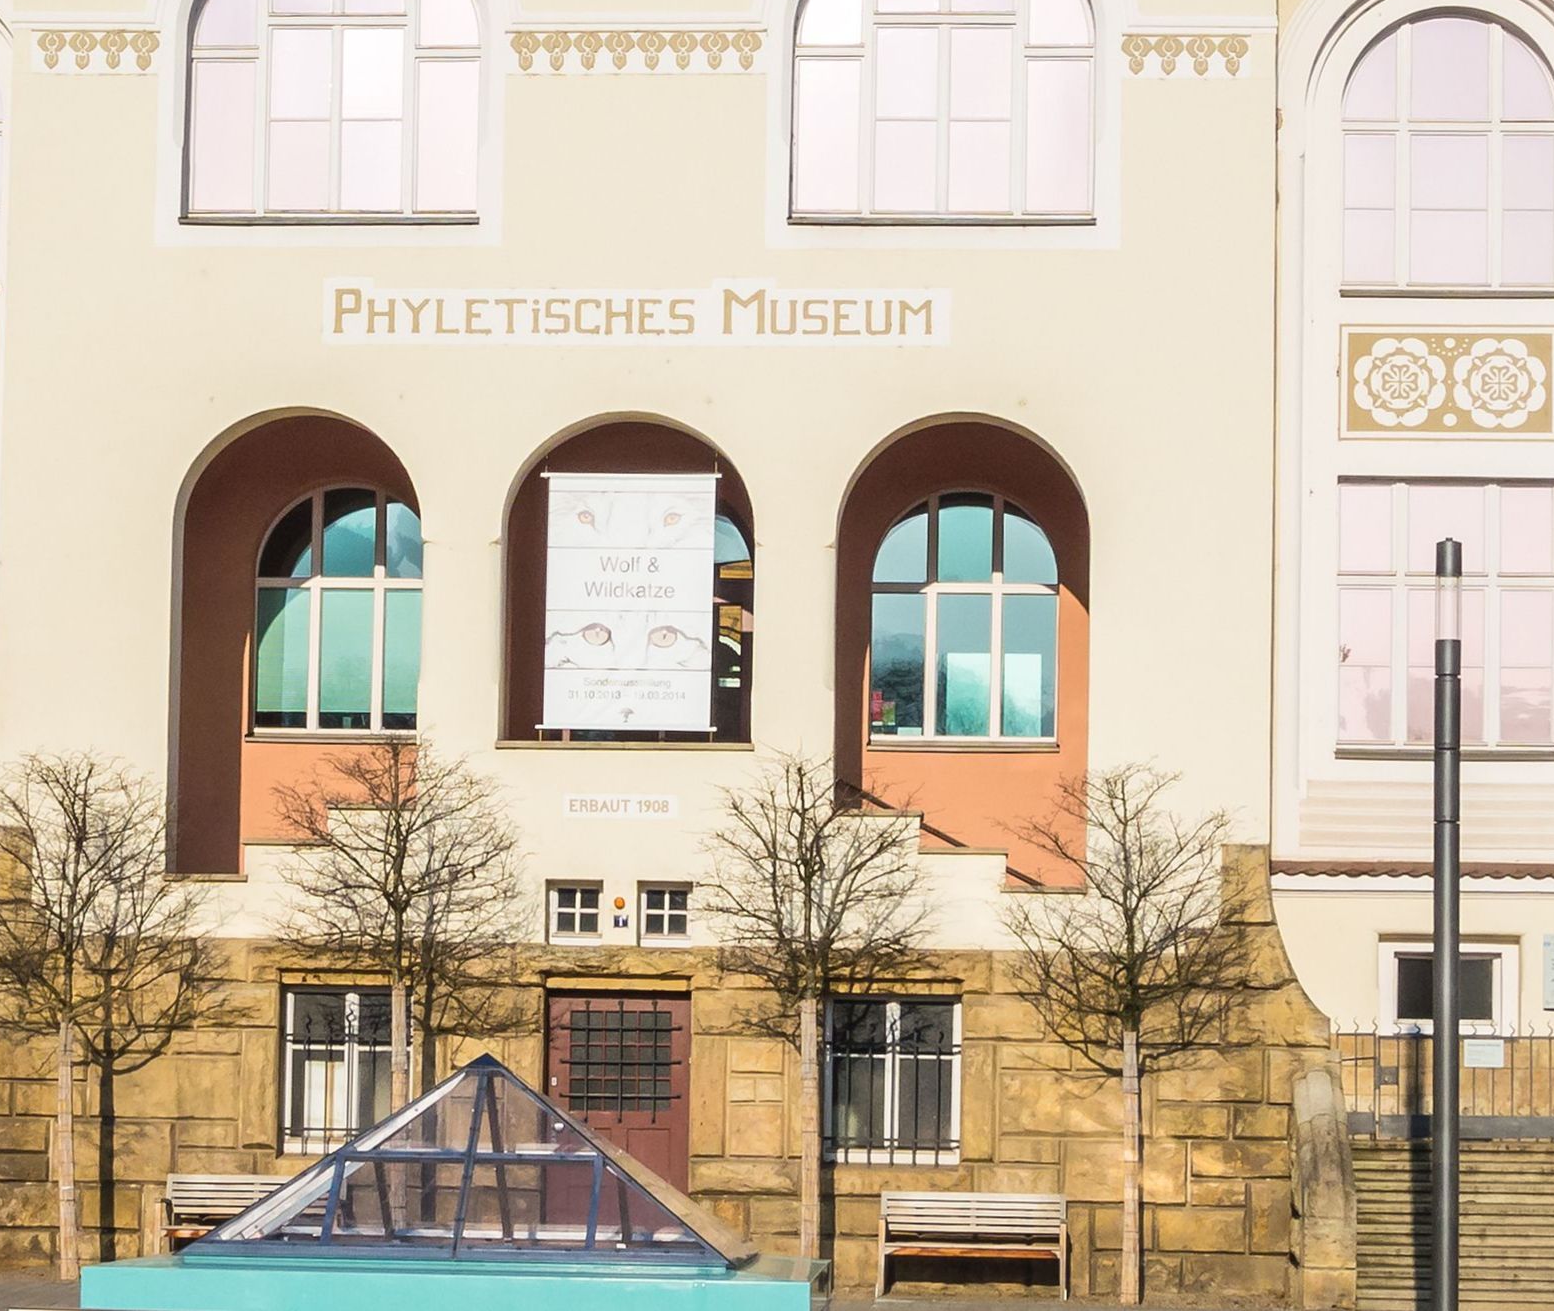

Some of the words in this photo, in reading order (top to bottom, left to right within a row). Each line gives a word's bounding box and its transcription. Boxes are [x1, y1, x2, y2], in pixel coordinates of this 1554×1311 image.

[599, 556, 640, 573] Wolf
[647, 557, 660, 573] &
[584, 581, 675, 598] Wildkatze
[583, 678, 671, 689] Sonderaussung
[569, 799, 631, 813] ERBAUT
[636, 800, 670, 813] 1908
